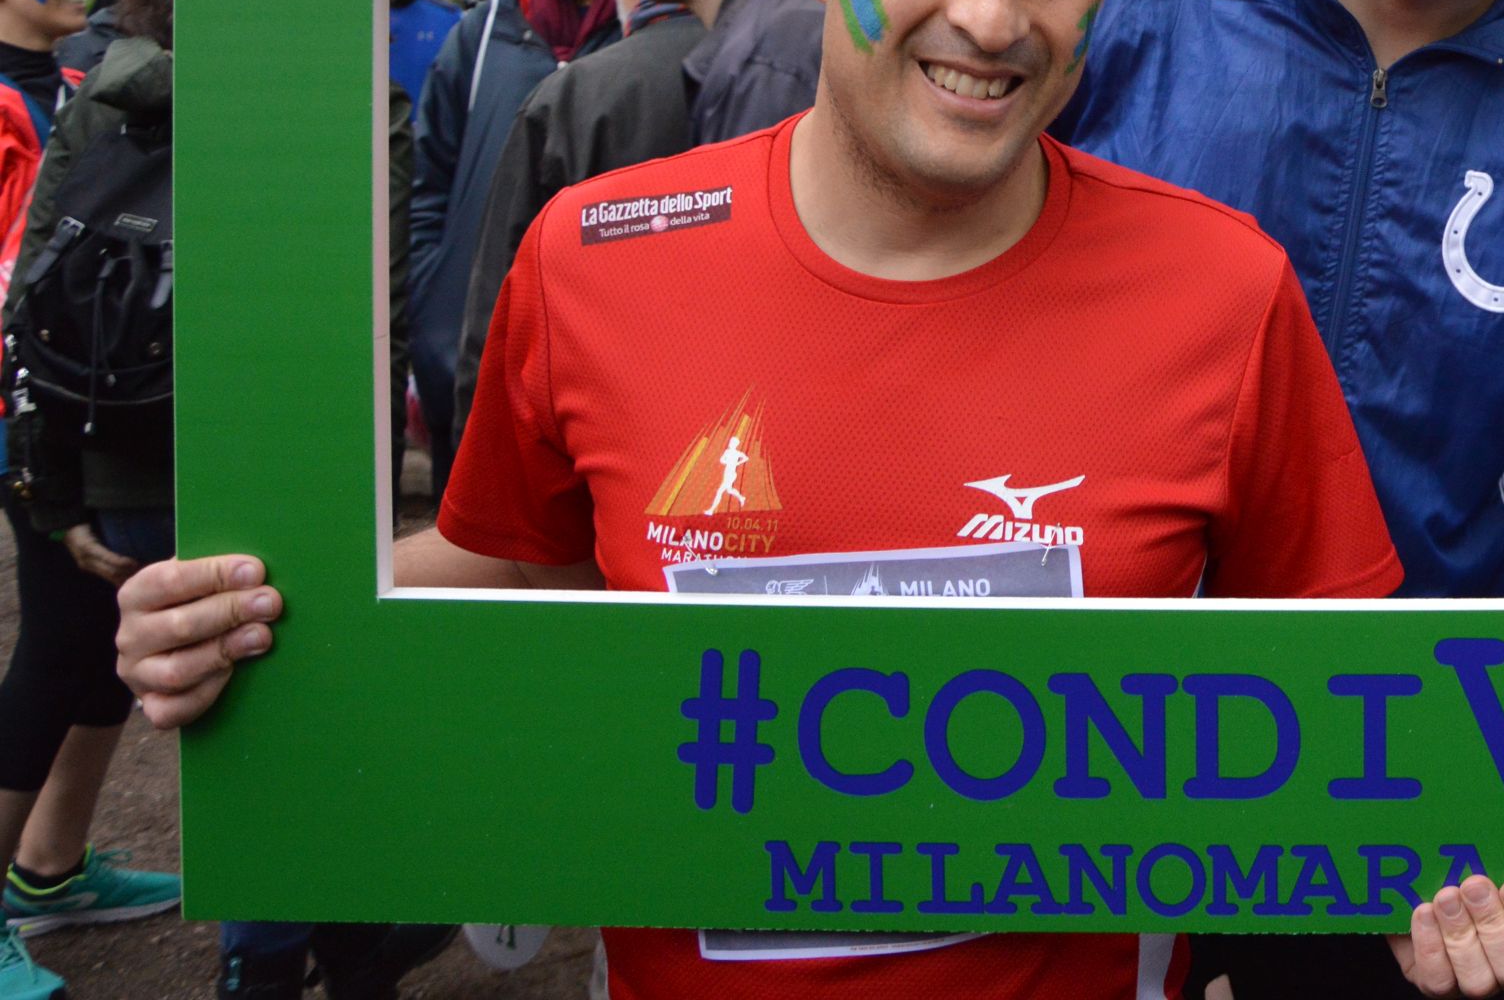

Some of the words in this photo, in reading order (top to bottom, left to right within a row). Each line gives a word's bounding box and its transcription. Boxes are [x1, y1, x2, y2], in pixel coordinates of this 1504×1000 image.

[581, 207, 597, 227] La
[599, 199, 659, 224] Gazzetta
[660, 193, 693, 215] dello
[694, 186, 733, 211] Sport
[599, 227, 624, 238] Tutto
[623, 225, 630, 234] il
[630, 223, 650, 234] rosa
[670, 215, 692, 227] della
[692, 212, 711, 222] vita
[726, 516, 779, 532] 10.04.11
[899, 578, 992, 597] MILANO
